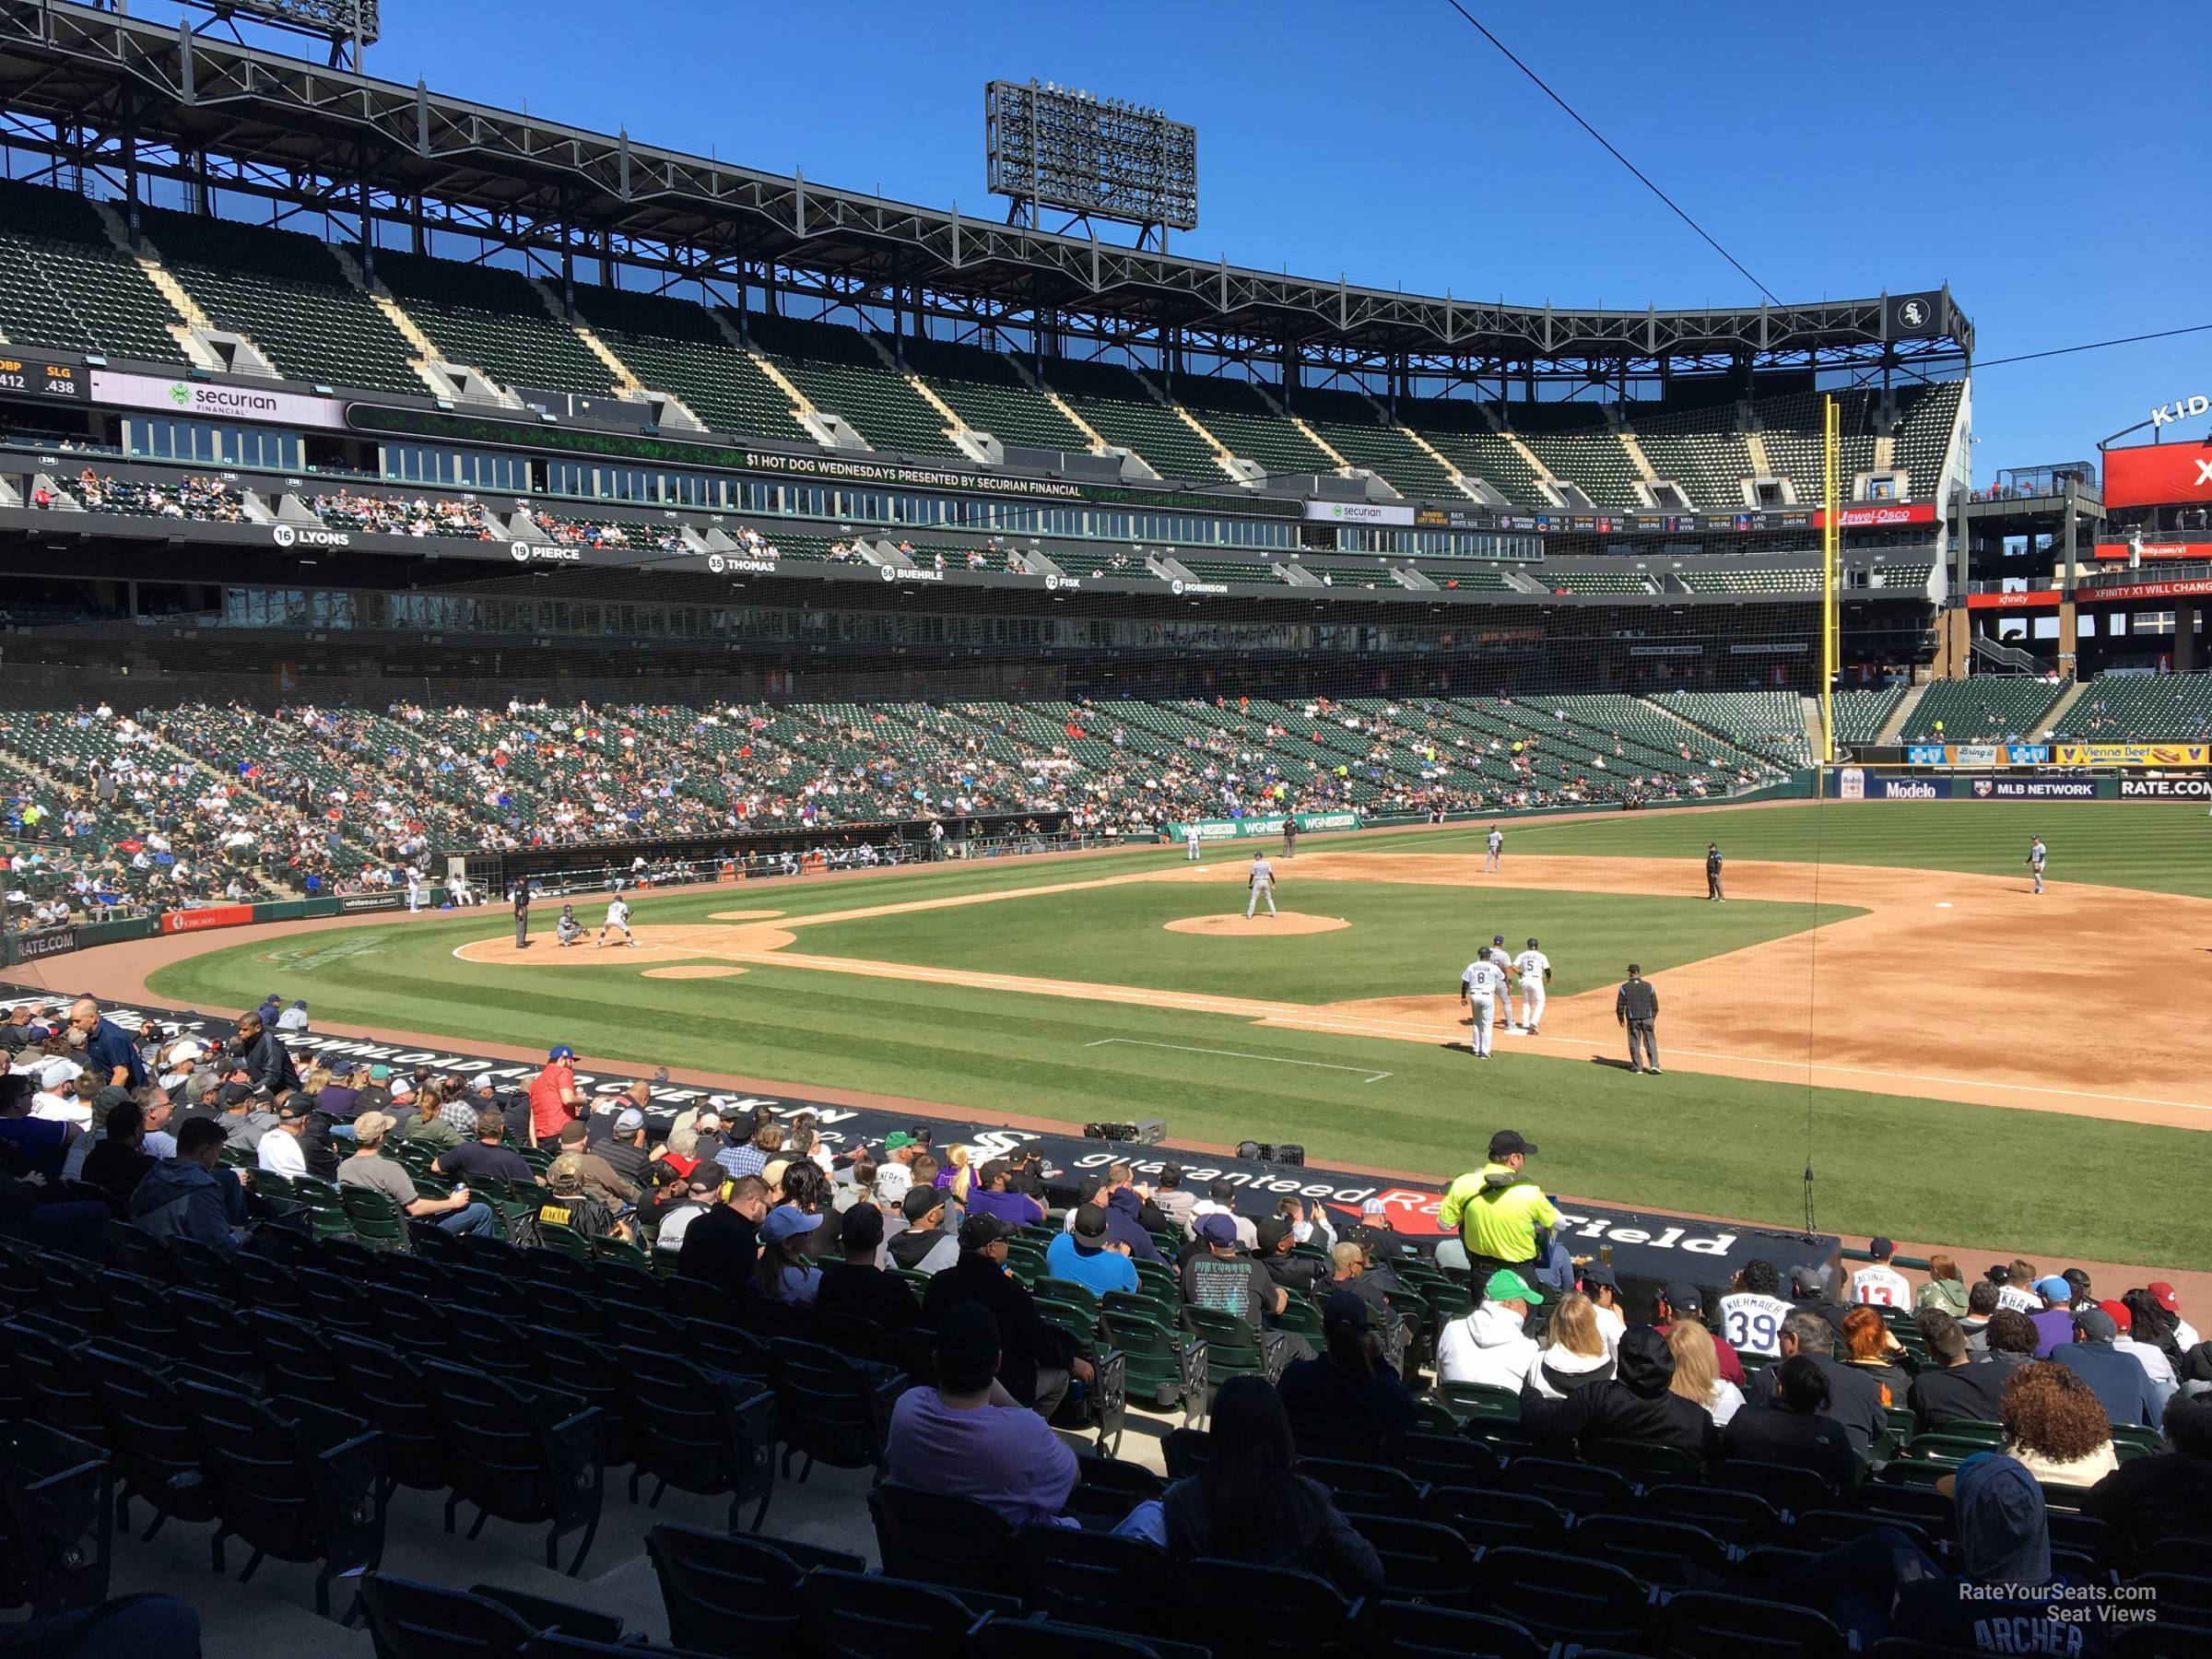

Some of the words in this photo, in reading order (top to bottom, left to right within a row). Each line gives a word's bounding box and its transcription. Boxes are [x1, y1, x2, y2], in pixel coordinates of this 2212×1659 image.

[47, 366, 71, 378] SLG
[44, 379, 75, 394] .438
[195, 387, 276, 411] securian
[196, 405, 246, 416] FINANCIAL
[747, 453, 759, 466] $1
[761, 455, 785, 469] HOT
[789, 459, 816, 472] DOG
[818, 461, 897, 480] WEDNESDAYS
[898, 470, 959, 486] PRESENTED
[961, 477, 975, 488] BY
[977, 477, 1029, 492] SECURIAN
[1030, 483, 1081, 497] FINANCIAL
[1344, 507, 1382, 517] securian
[277, 529, 290, 541] 16
[299, 530, 350, 546] LYONS
[514, 546, 526, 557] 19
[532, 547, 581, 560] PIERCE
[710, 559, 723, 568] 35
[727, 559, 775, 572] THOMAS
[883, 569, 894, 577] 56
[897, 569, 944, 581] BUEHRLE
[1047, 578, 1056, 586] 72
[1060, 578, 1081, 588] FISK
[1172, 582, 1183, 593] 42
[1184, 582, 1228, 594] ROBINSON
[2095, 587, 2130, 598] XFINITY
[2132, 586, 2143, 595] X1
[2146, 584, 2171, 594] WILL
[1999, 594, 2030, 606] xfinity
[1959, 747, 1988, 758] Bring
[1986, 748, 1994, 757] it
[2082, 747, 2123, 757] Vienna
[2124, 747, 2150, 757] Beef
[1887, 782, 1936, 799] Modelo
[1997, 784, 2026, 794] MLB
[2028, 784, 2093, 795] NETWORK
[1207, 823, 1237, 834] SPORTS
[1244, 821, 1271, 834] WGN
[1304, 817, 1330, 830] WGN
[1328, 815, 1355, 827] SPORTS
[345, 897, 396, 908] whitesox.com
[18, 933, 74, 958] RATE.COM
[1526, 959, 1535, 971] 5
[1477, 972, 1486, 983] 8
[1859, 1285, 1893, 1306] 13
[1726, 1299, 1783, 1316] KIERMAIER
[1728, 1311, 1778, 1352] 39
[1973, 1617, 2084, 1658] ARCHER
